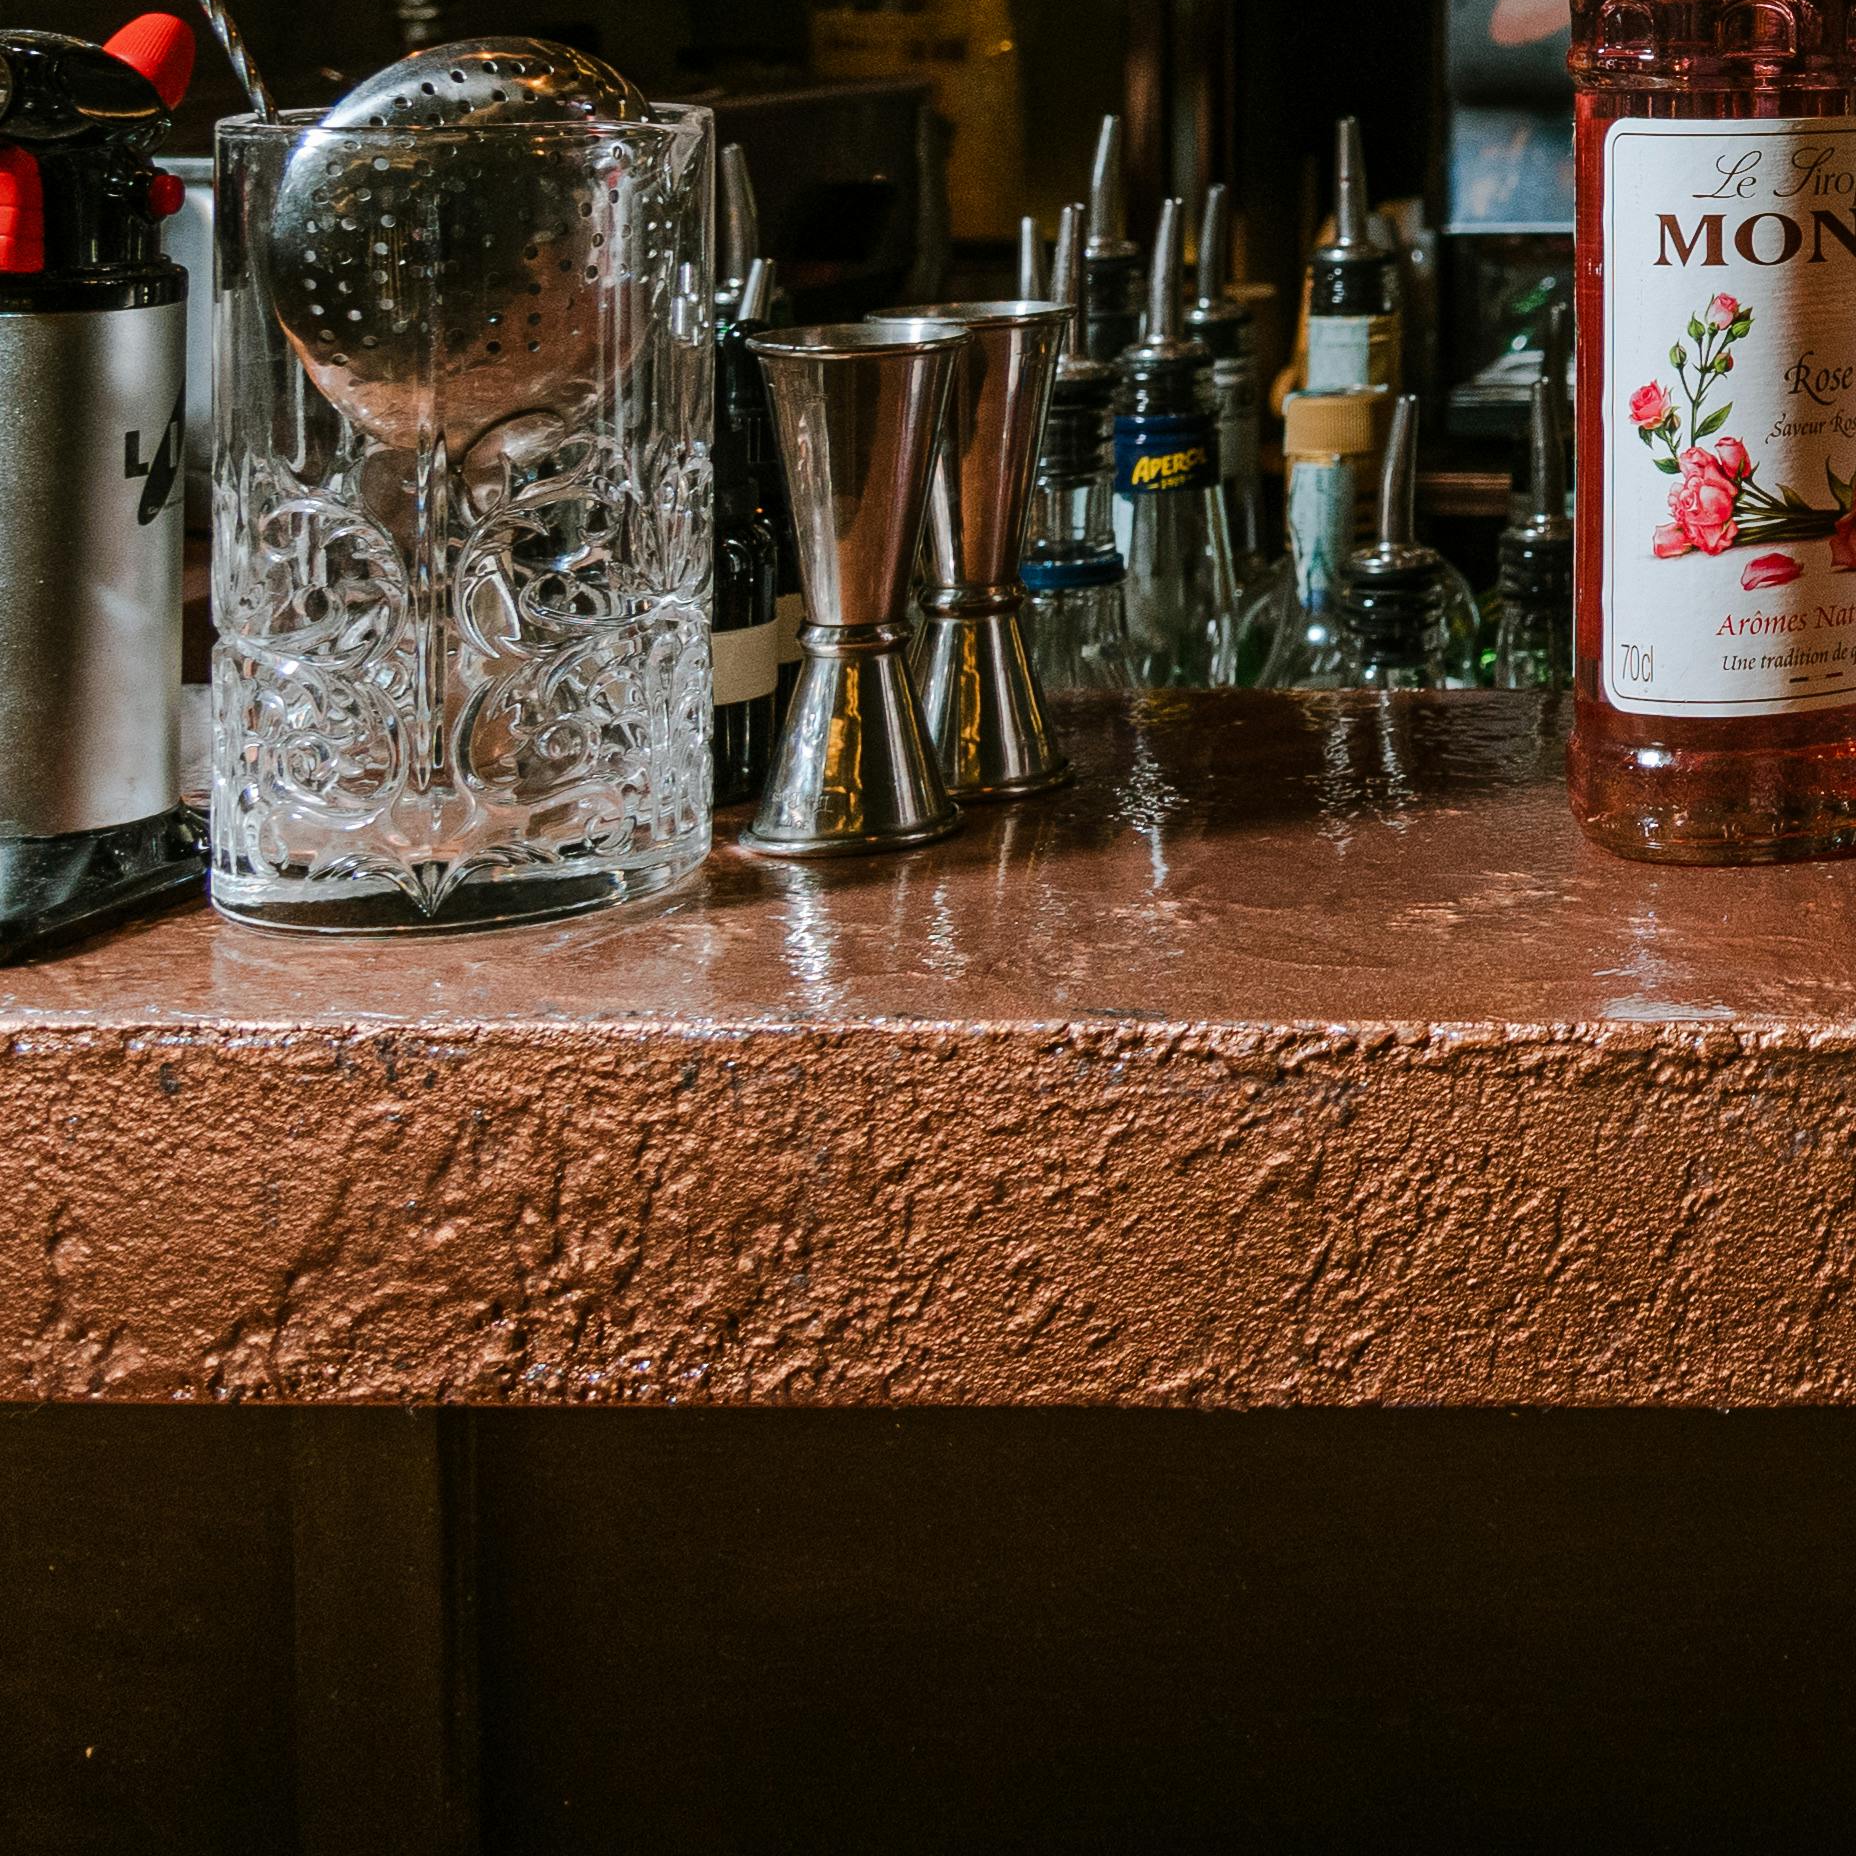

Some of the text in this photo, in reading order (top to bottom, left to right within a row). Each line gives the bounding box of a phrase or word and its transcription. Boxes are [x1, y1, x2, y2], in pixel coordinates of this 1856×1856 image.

[1691, 150, 1763, 199] Le
[1784, 350, 1853, 405] Rose
[1765, 413, 1826, 444] Saveur
[1716, 610, 1808, 636] Arômes
[1621, 644, 1654, 682] 70cl
[1722, 655, 1756, 671] Une
[1761, 647, 1828, 669] tradition
[1832, 642, 1849, 661] de
